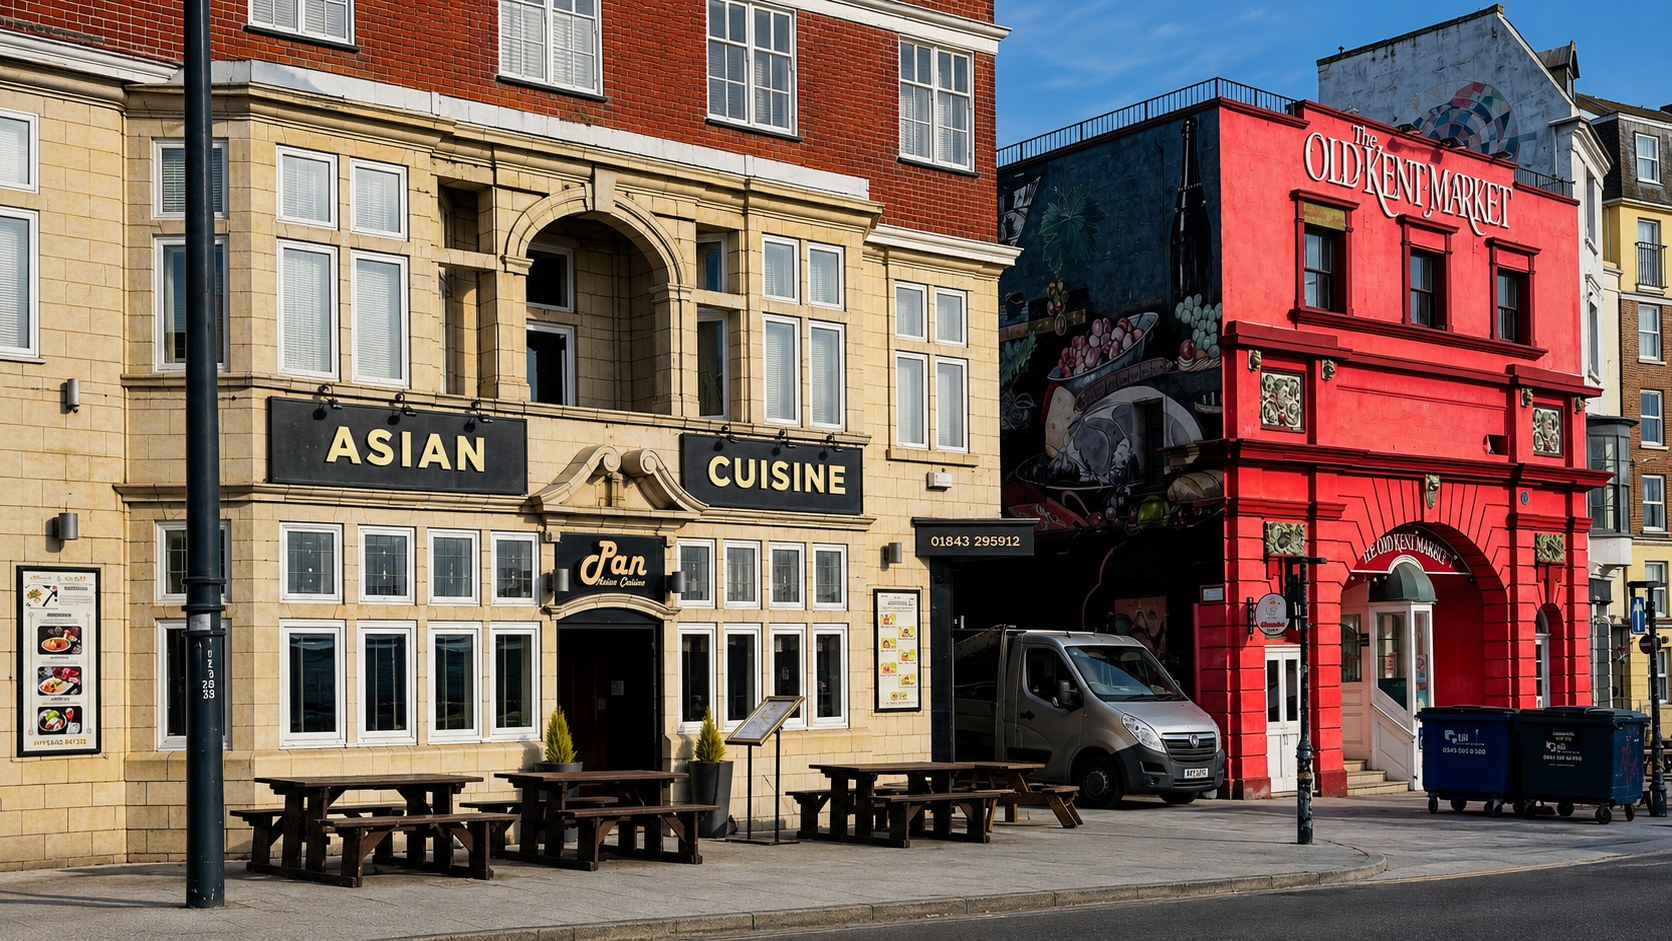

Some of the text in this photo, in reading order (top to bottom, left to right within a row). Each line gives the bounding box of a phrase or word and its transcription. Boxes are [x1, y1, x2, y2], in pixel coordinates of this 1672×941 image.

[1353, 124, 1377, 147] The
[1304, 132, 1513, 236] OLD KENT MARKET
[325, 425, 485, 473] ASIAN
[708, 455, 846, 495] CUISINE
[930, 536, 1020, 547] 01843 295912
[1393, 533, 1415, 554] KENT
[580, 540, 647, 586] Pan
